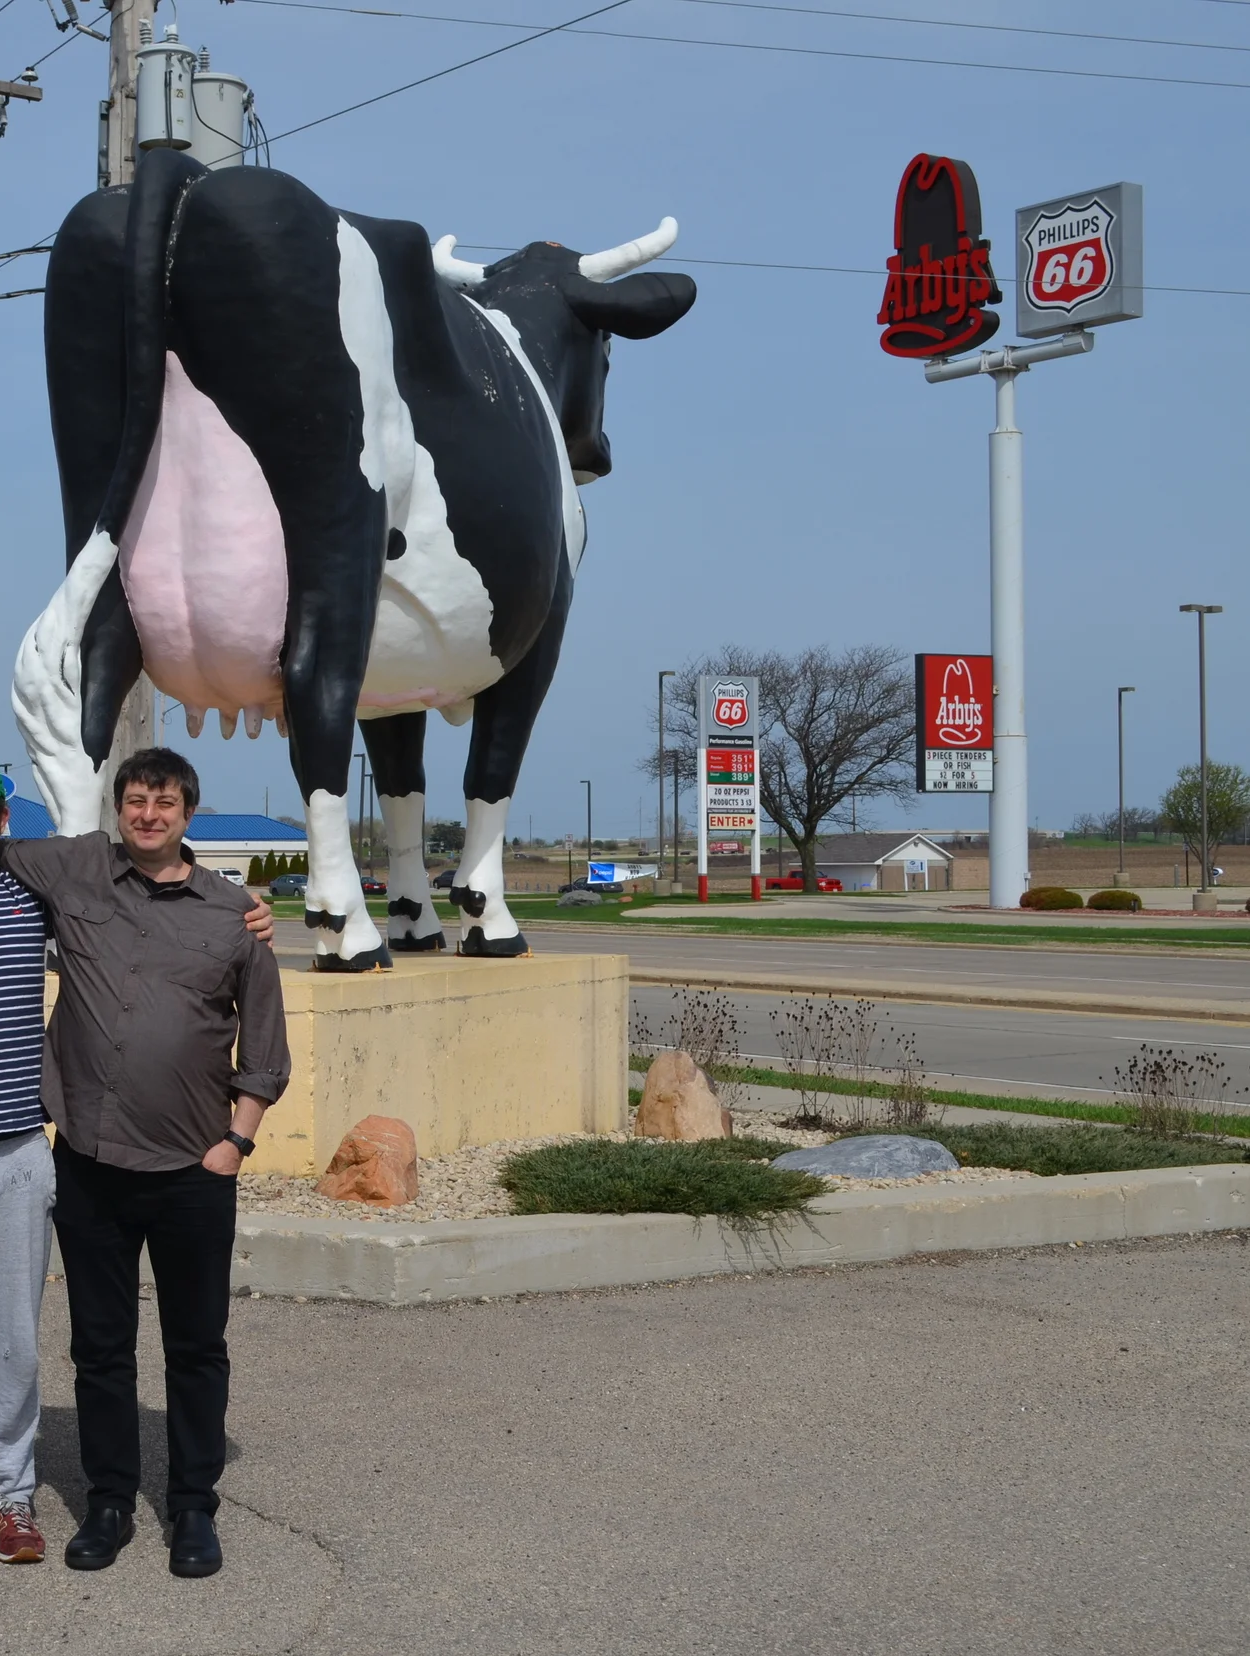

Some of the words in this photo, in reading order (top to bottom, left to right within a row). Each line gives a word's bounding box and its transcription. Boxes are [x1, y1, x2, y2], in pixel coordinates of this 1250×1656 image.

[1038, 215, 1100, 247] PHILLIPS
[1041, 246, 1096, 293] 66
[877, 237, 991, 325] Arby's
[718, 688, 744, 698] PHILLIPS
[719, 702, 743, 720] 66
[935, 695, 983, 732] Arby's
[927, 752, 931, 760] 3
[932, 752, 952, 760] PIECE
[956, 752, 987, 760] TENDERS
[943, 761, 953, 770] OR
[957, 761, 972, 770] FISH
[940, 771, 947, 780] $2
[952, 771, 965, 780] FOR
[971, 771, 975, 780] 5
[933, 781, 948, 790] NOW
[955, 781, 978, 790] HIRING
[714, 788, 722, 796] 20
[724, 788, 731, 796] OZ
[733, 788, 749, 796] PEPSI
[710, 798, 738, 806] PRODUCTS
[710, 816, 746, 827] ENTER
